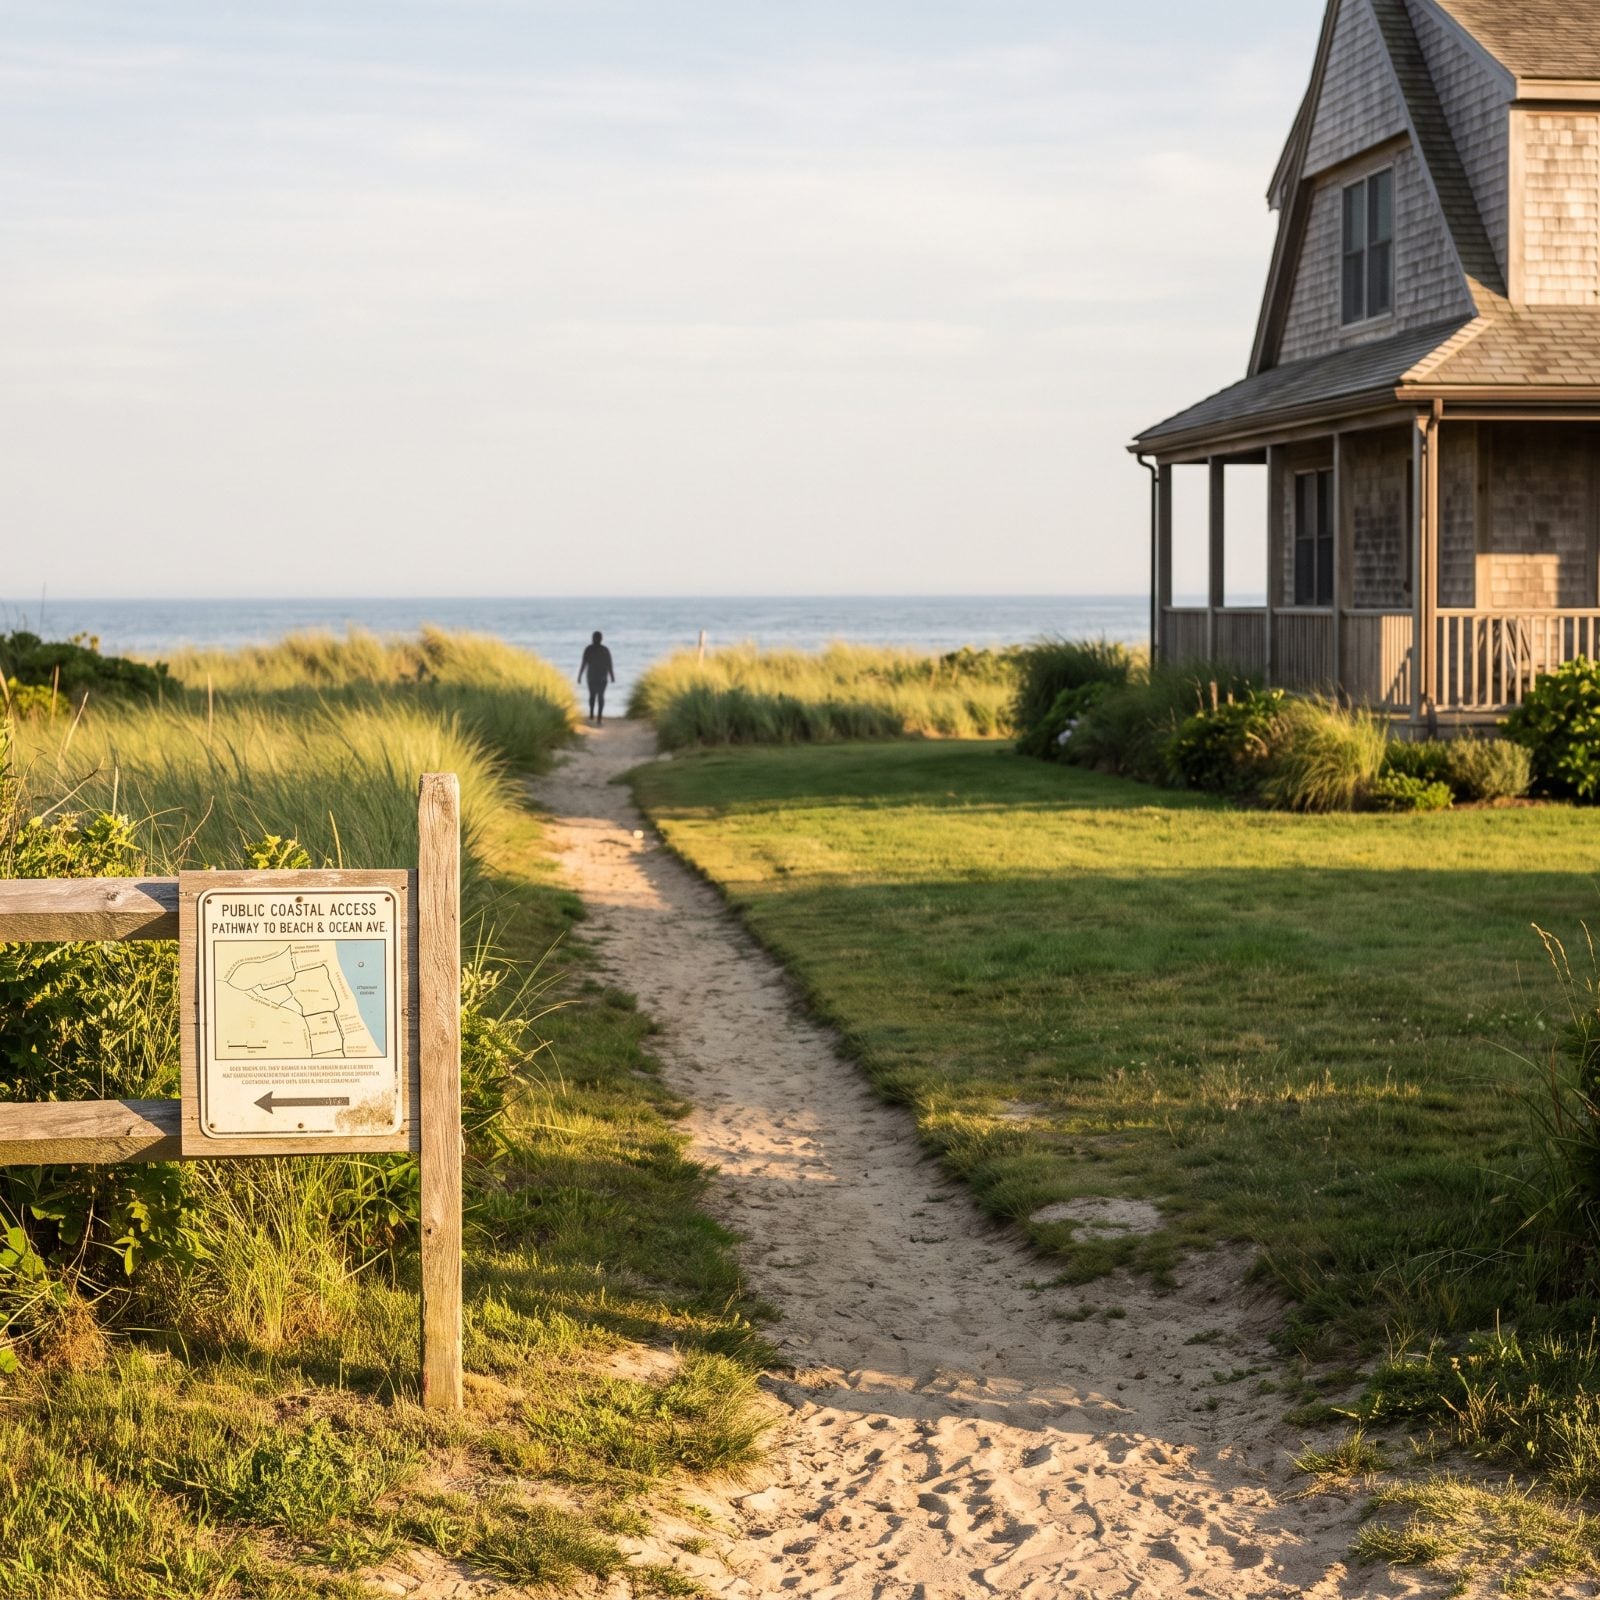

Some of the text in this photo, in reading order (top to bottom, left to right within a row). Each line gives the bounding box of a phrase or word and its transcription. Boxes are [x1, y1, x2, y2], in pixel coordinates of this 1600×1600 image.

[222, 903, 377, 917] PUBLIC COASTAL ACCESS
[212, 921, 388, 934] PATHWAY TO BEACH & OCEAN AVE.
